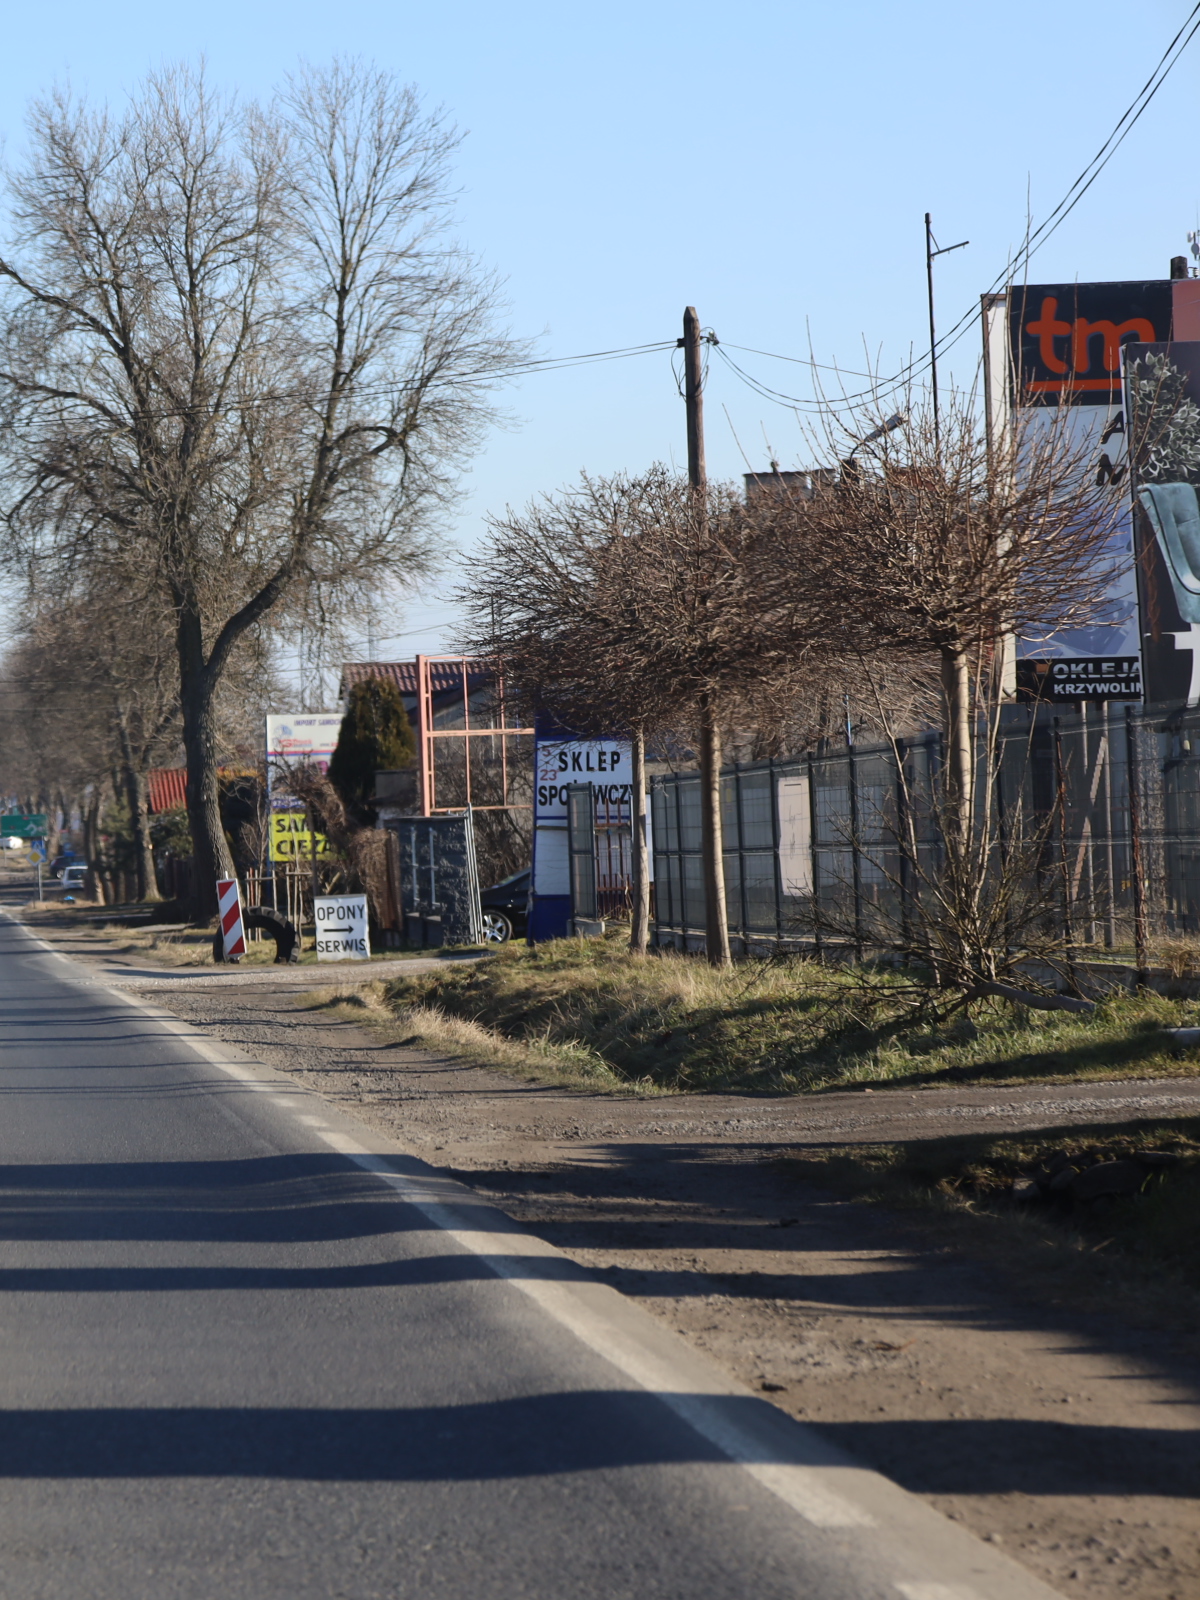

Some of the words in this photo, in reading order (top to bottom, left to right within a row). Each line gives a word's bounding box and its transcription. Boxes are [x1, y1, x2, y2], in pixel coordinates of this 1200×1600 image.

[1025, 296, 1156, 374] tm
[558, 751, 621, 772] SKLEP
[540, 769, 557, 781] 23
[538, 784, 634, 807] SPOWCZ
[316, 904, 365, 921] OPONY
[317, 938, 366, 953] SERWIS
